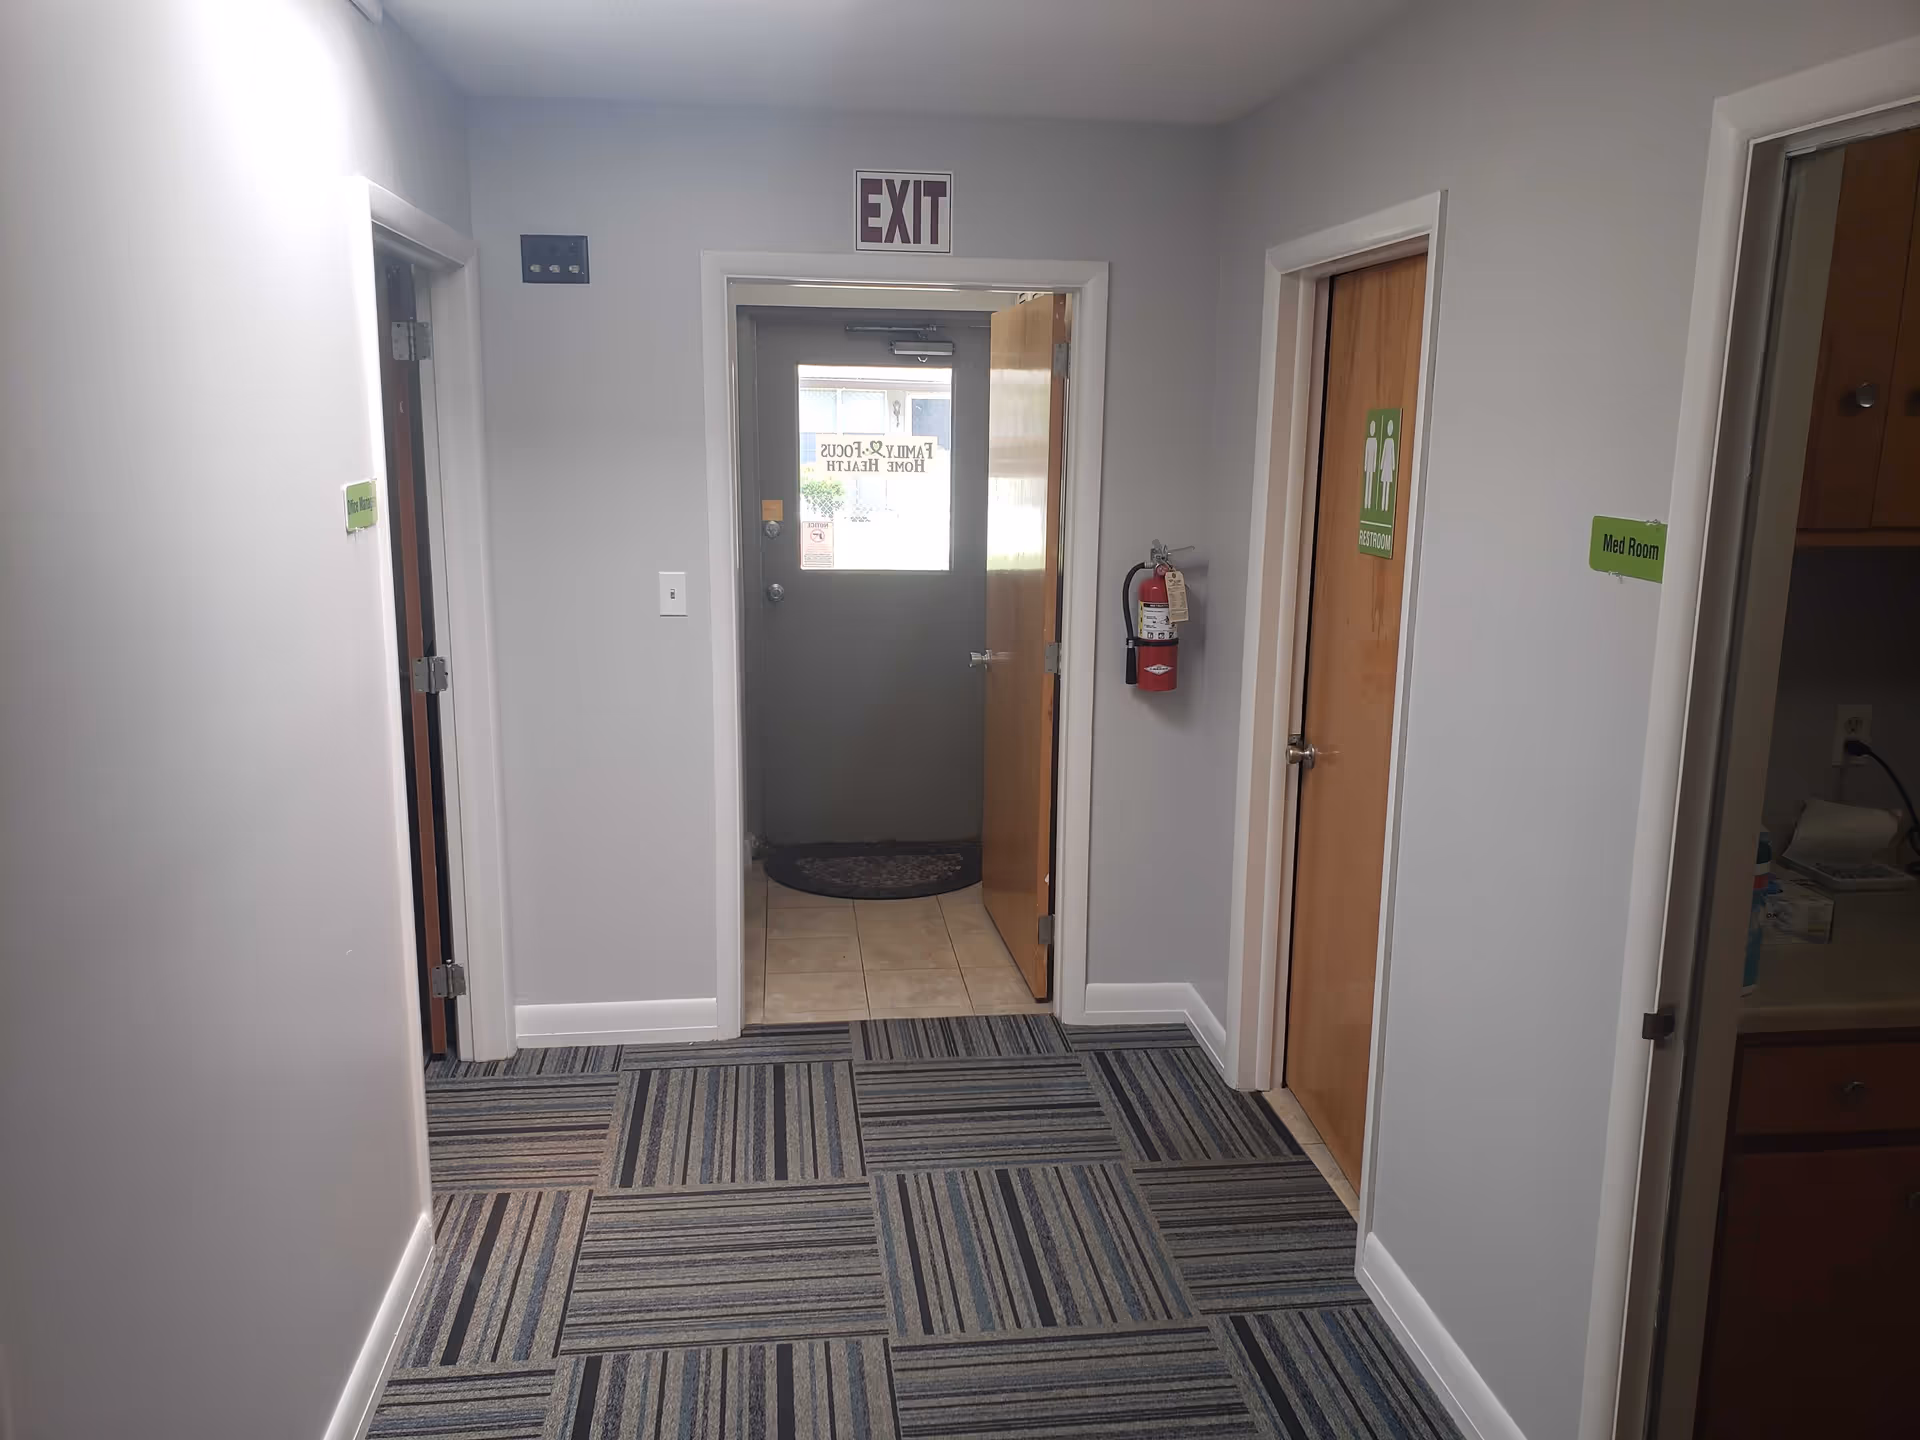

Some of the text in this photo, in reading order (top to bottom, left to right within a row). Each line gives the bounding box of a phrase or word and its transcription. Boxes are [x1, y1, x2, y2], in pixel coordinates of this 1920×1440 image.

[860, 178, 947, 245] EXIT
[1358, 529, 1391, 551] RESTROOM
[1603, 533, 1659, 560] Med Room
